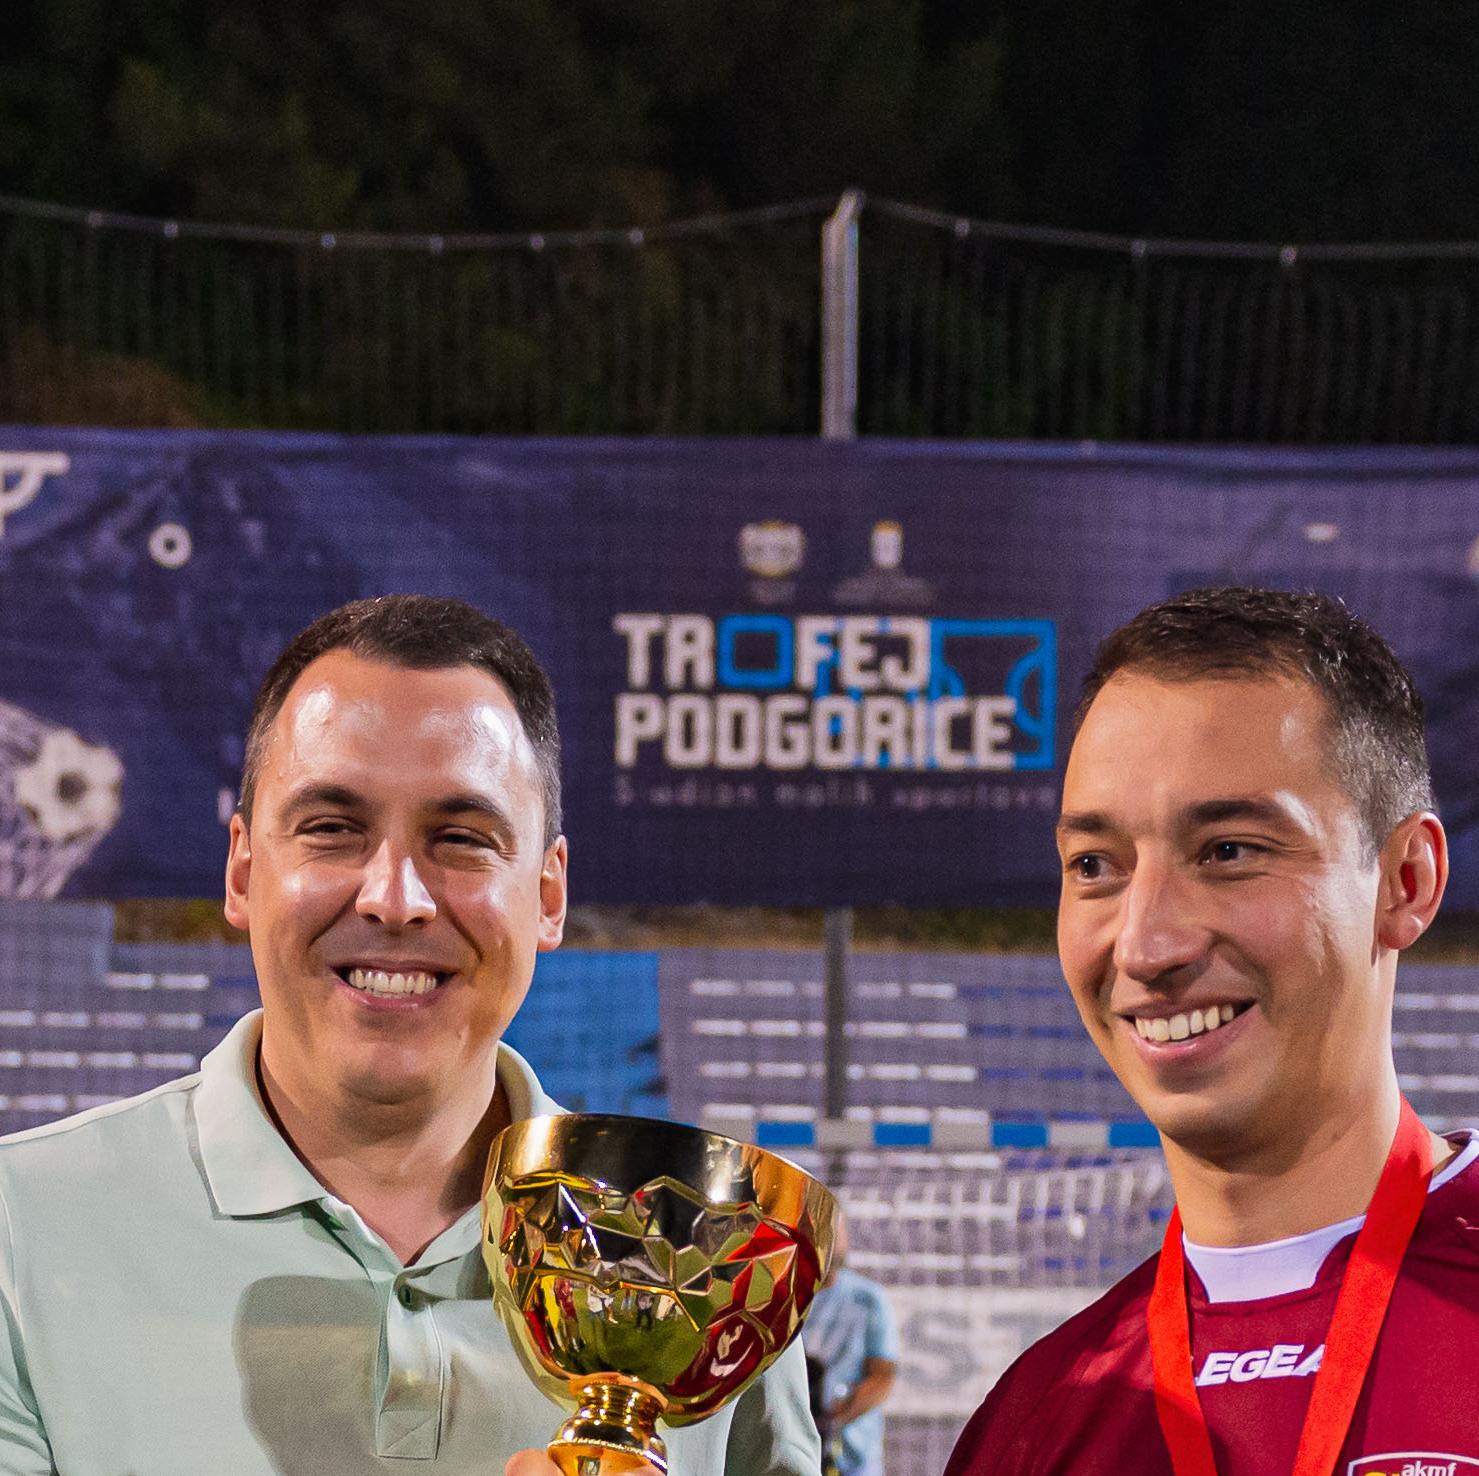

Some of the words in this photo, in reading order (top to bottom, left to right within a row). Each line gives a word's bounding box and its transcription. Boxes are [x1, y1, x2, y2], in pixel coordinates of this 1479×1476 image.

[613, 613, 932, 690] TROFEJ
[614, 693, 1018, 770] PODGORICE
[1192, 1343, 1326, 1387] EGEA
